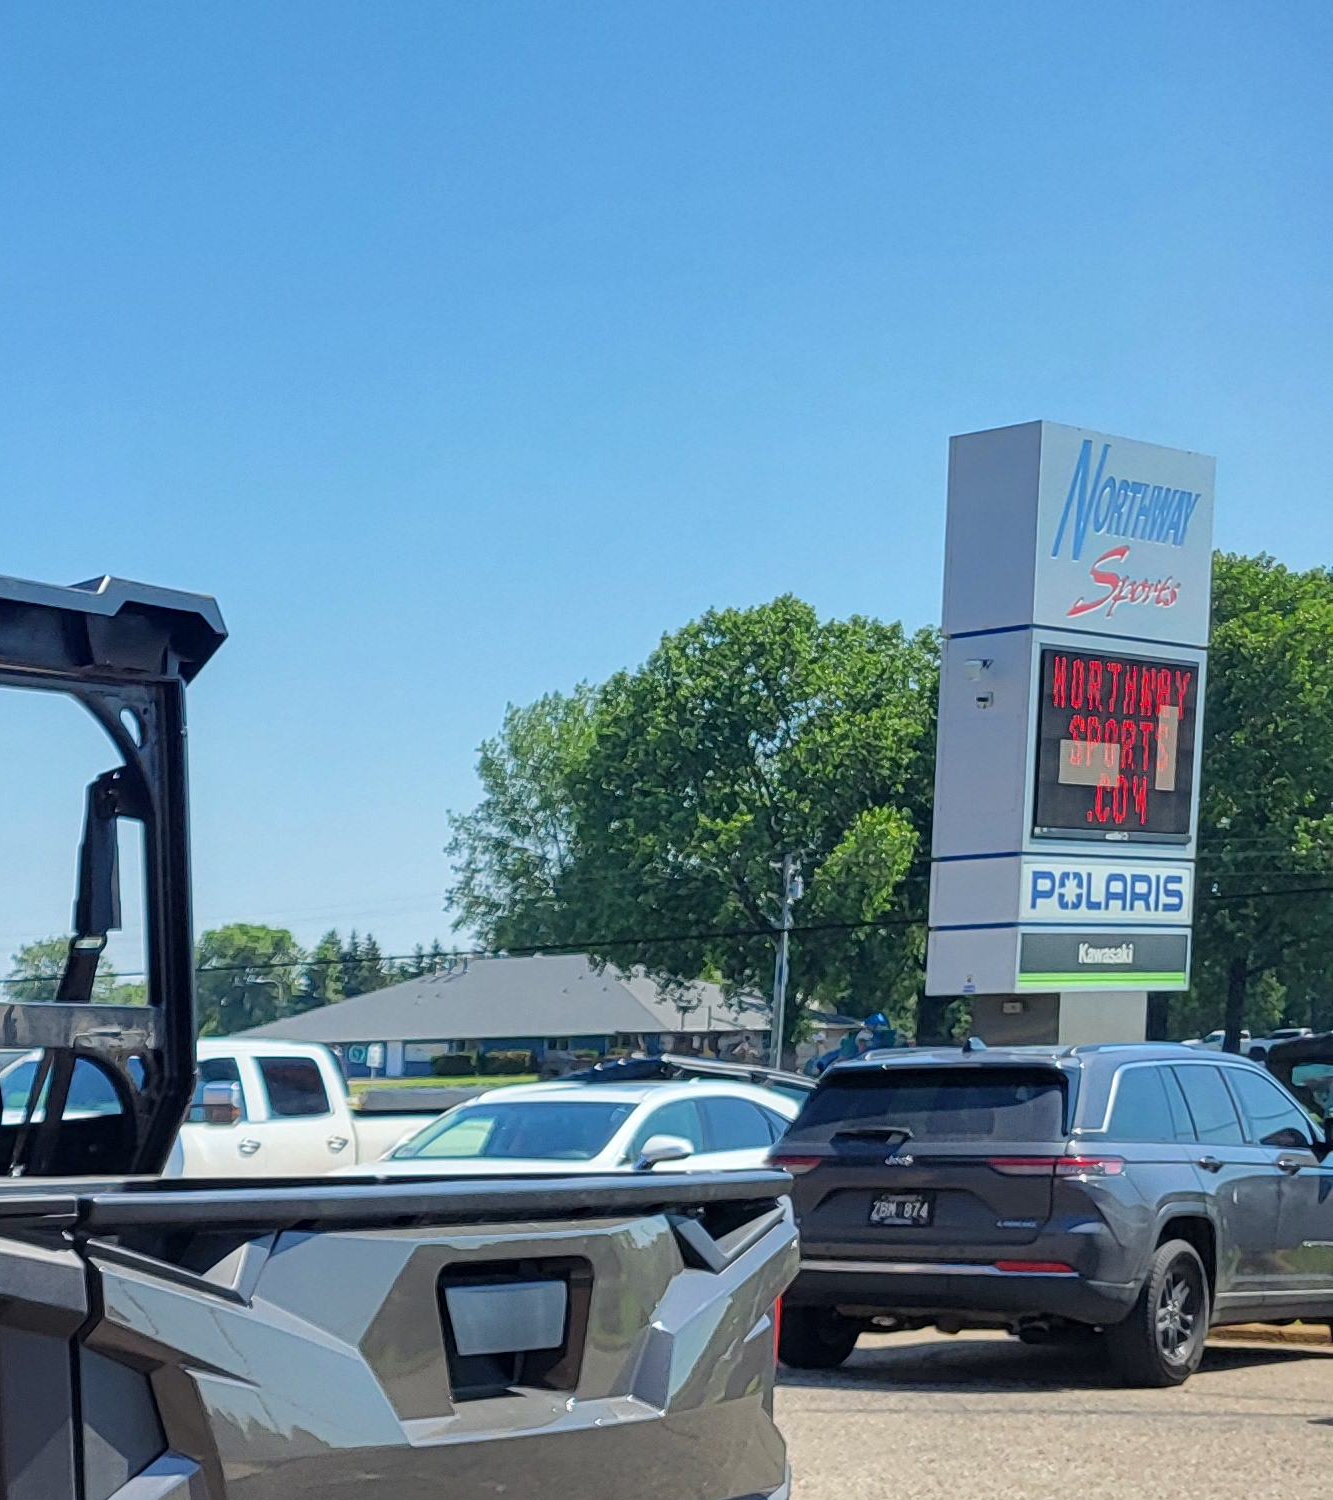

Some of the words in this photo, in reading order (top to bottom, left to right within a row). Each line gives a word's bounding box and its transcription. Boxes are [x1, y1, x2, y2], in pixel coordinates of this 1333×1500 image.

[1050, 438, 1202, 562] NORTHWAY
[1065, 544, 1181, 619] Sports
[1052, 655, 1192, 720] NORTHWAY
[1068, 714, 1170, 772] SPORTS
[1030, 870, 1184, 913] POLARIS
[1077, 942, 1134, 965] Kawasaki
